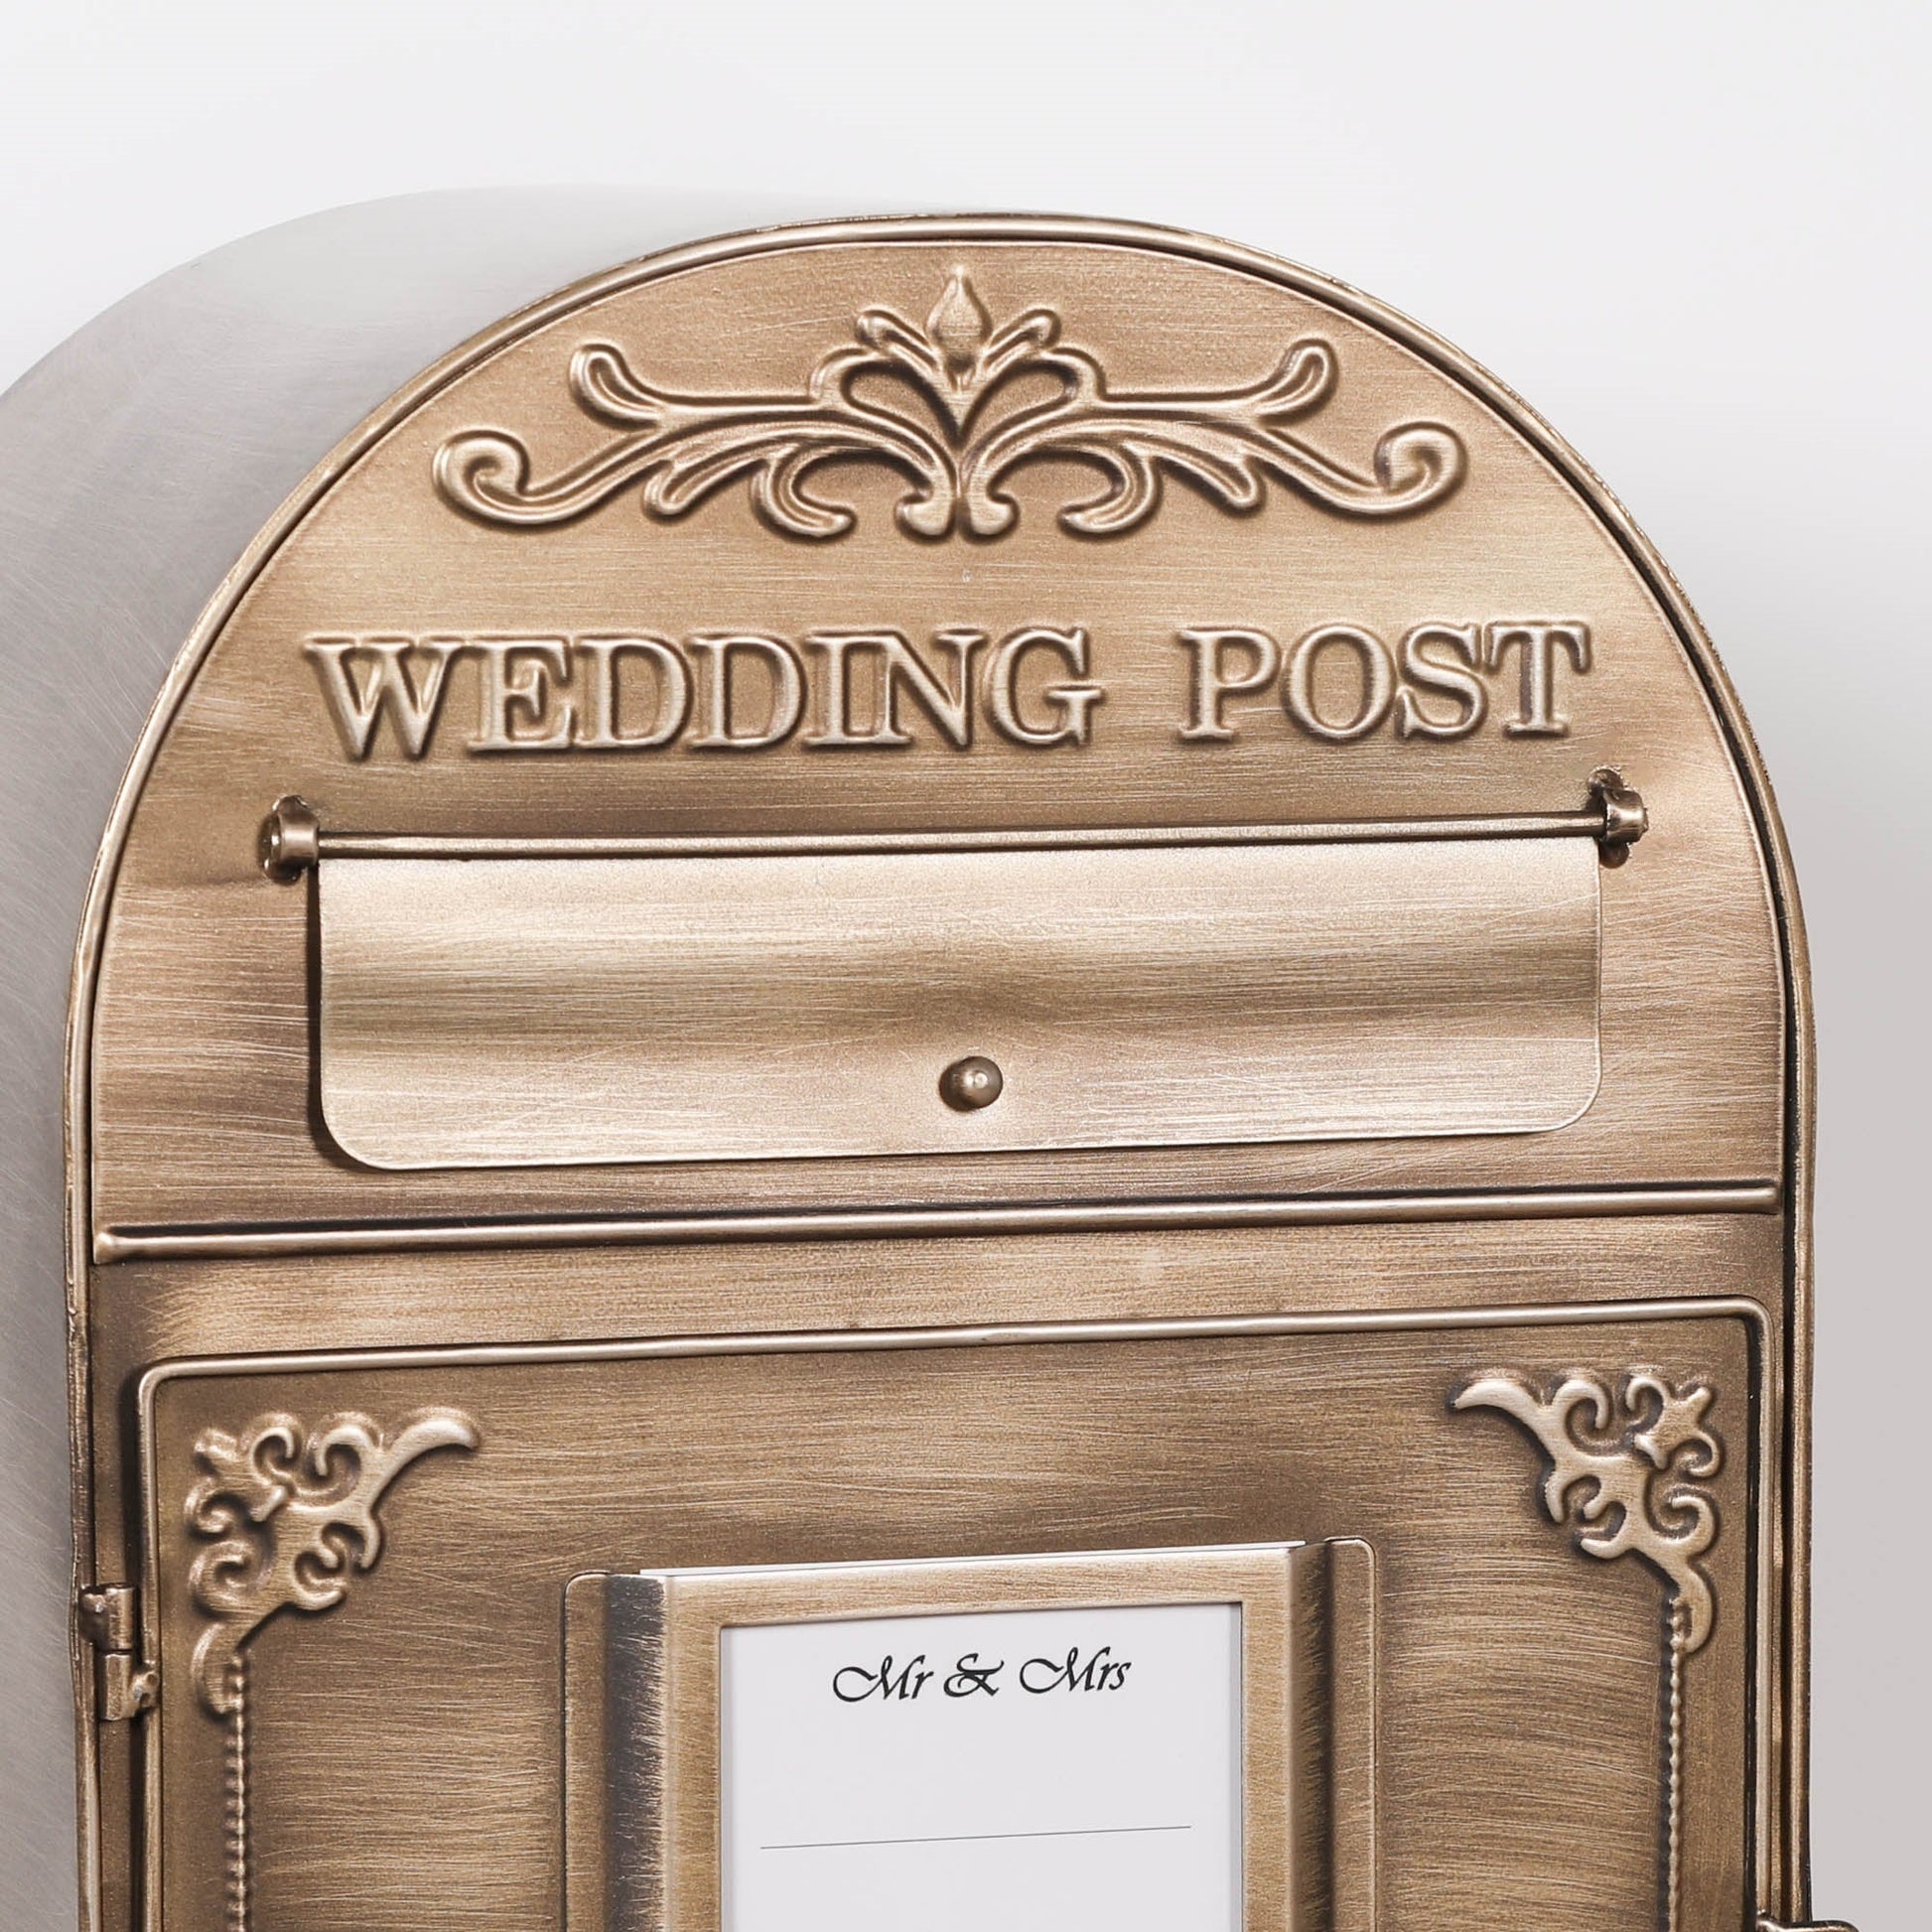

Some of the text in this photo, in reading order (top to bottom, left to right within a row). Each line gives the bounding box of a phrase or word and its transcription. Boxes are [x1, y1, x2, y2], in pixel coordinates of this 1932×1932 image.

[303, 619, 1592, 760] WEDDING POST
[832, 1646, 1132, 1703] Mr & Mrs
